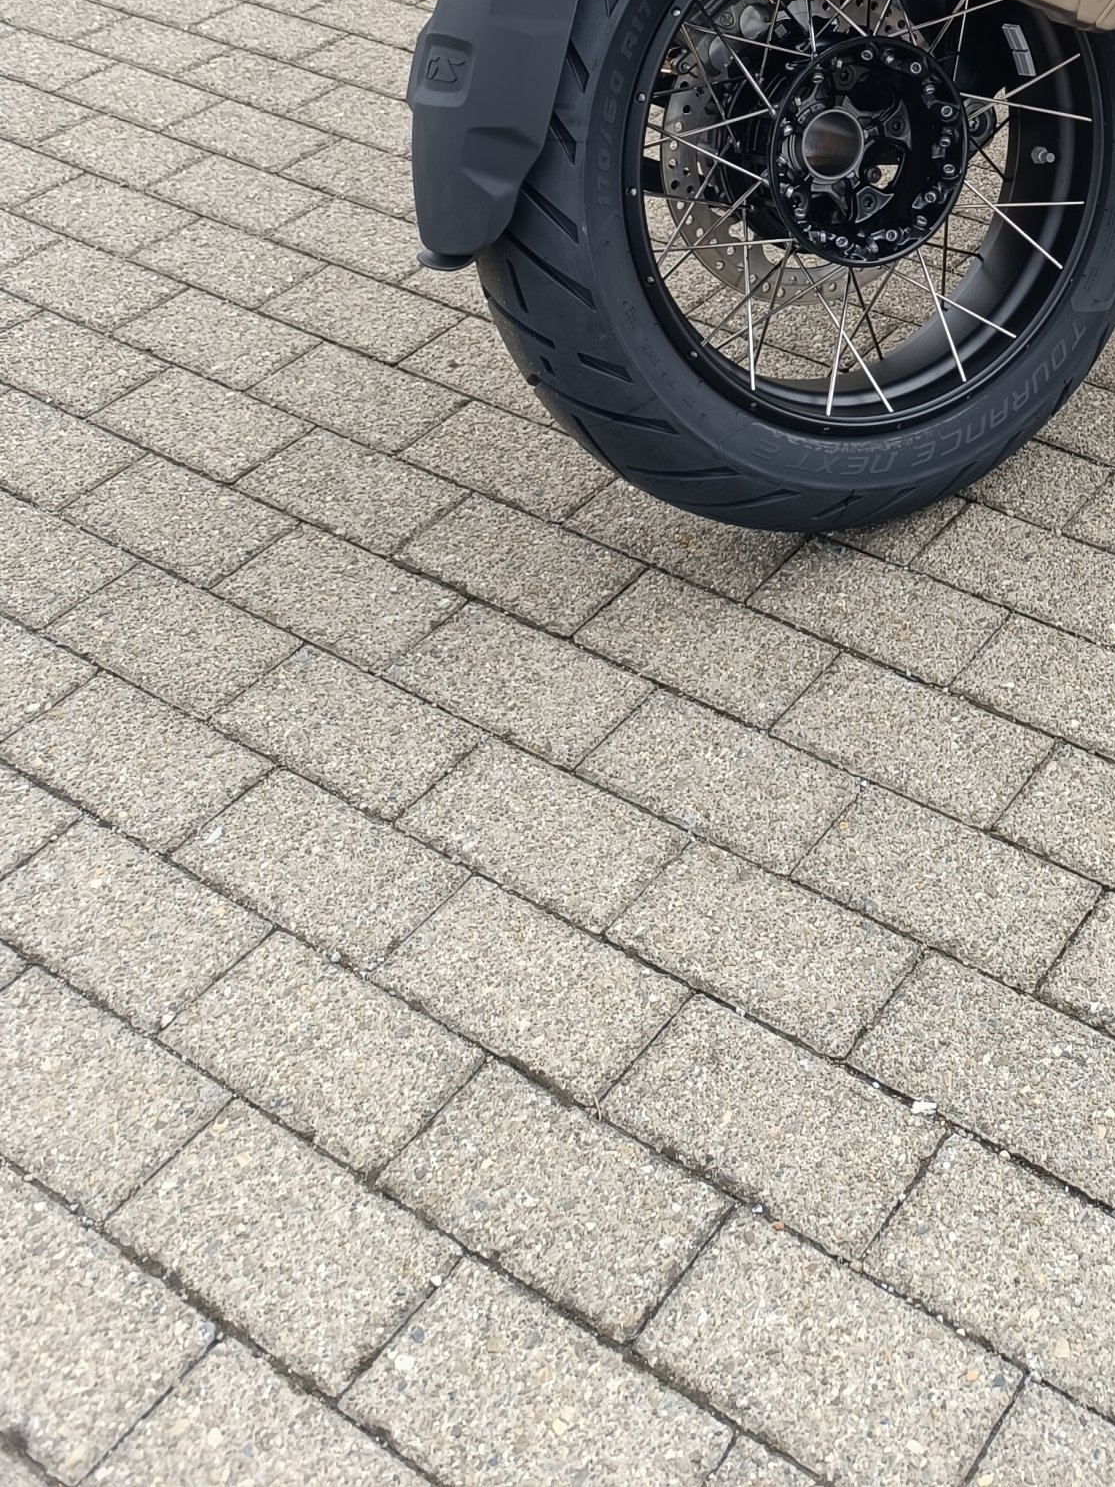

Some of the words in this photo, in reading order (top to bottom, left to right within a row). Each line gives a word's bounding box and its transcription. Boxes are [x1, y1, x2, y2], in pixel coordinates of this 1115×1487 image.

[597, 73, 626, 208] 170/60
[618, 14, 649, 58] R17
[911, 318, 1087, 465] TOURANCE
[749, 435, 781, 463] 2
[780, 450, 897, 476] NEXT
